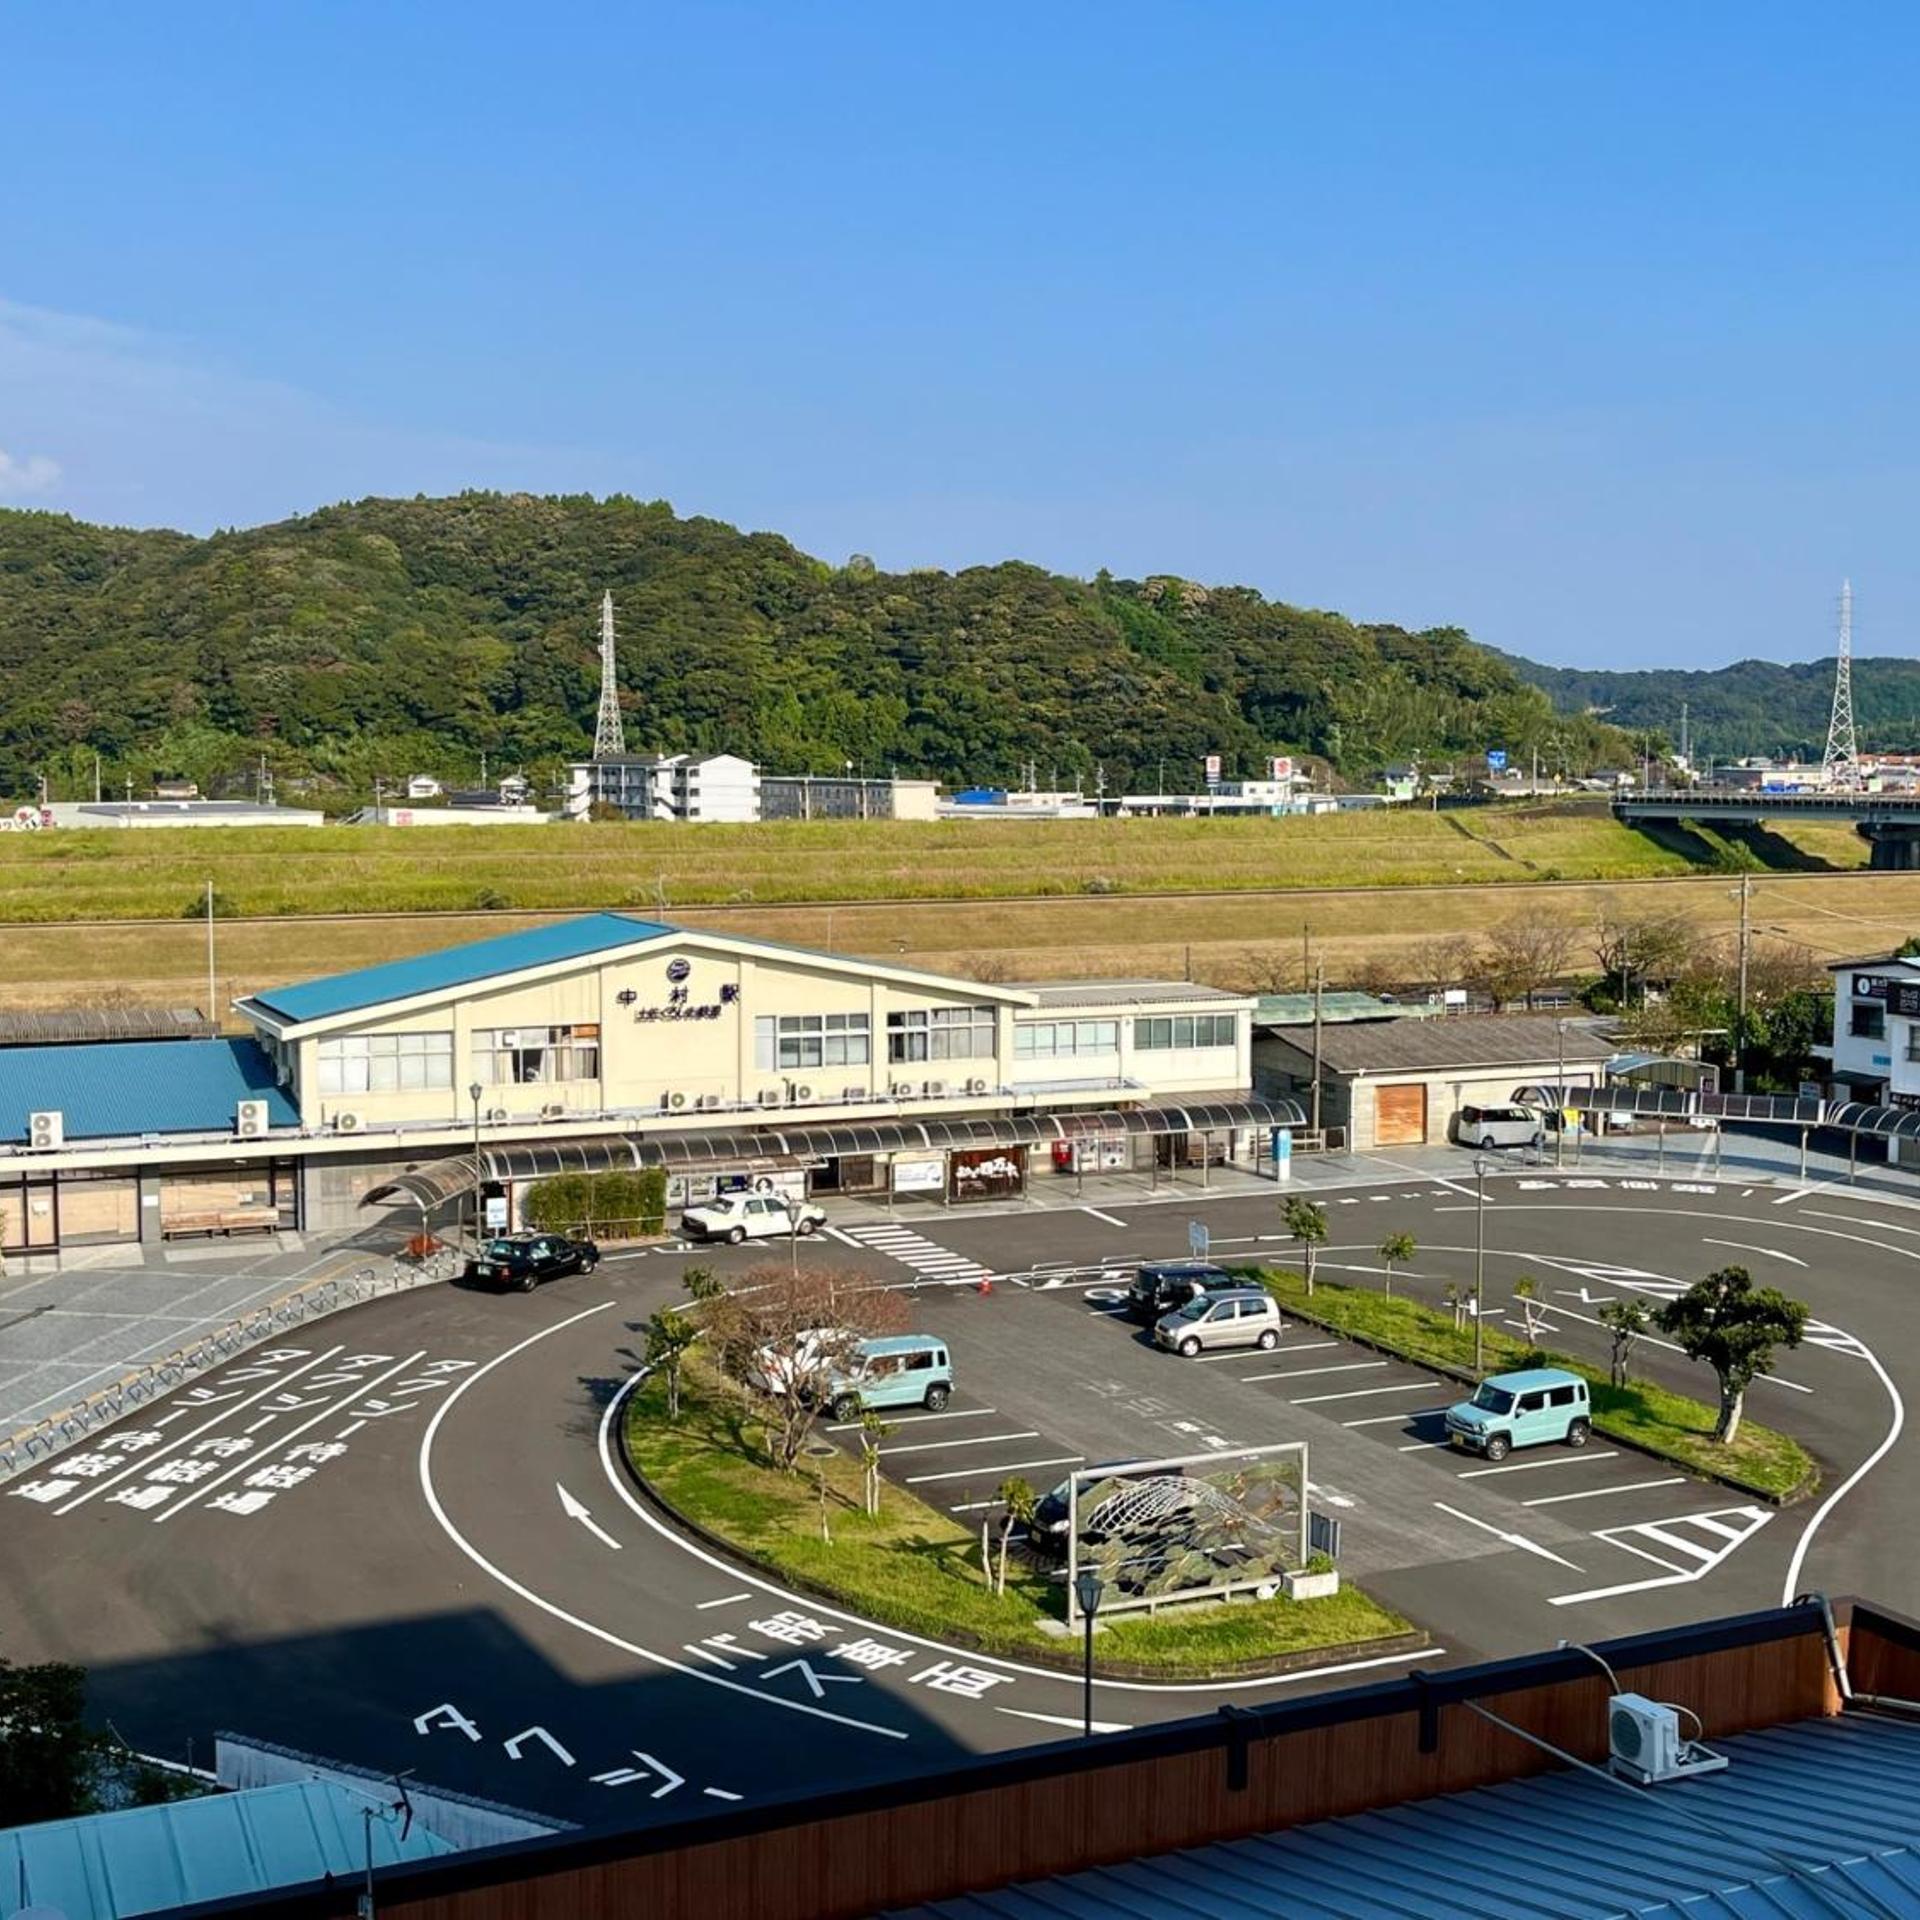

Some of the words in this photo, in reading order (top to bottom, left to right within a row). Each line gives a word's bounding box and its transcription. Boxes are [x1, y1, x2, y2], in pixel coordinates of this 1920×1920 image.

[682, 1632, 862, 1698] バス
[695, 1593, 1016, 1700] 一般車両
[414, 1704, 742, 1801] タクシー
